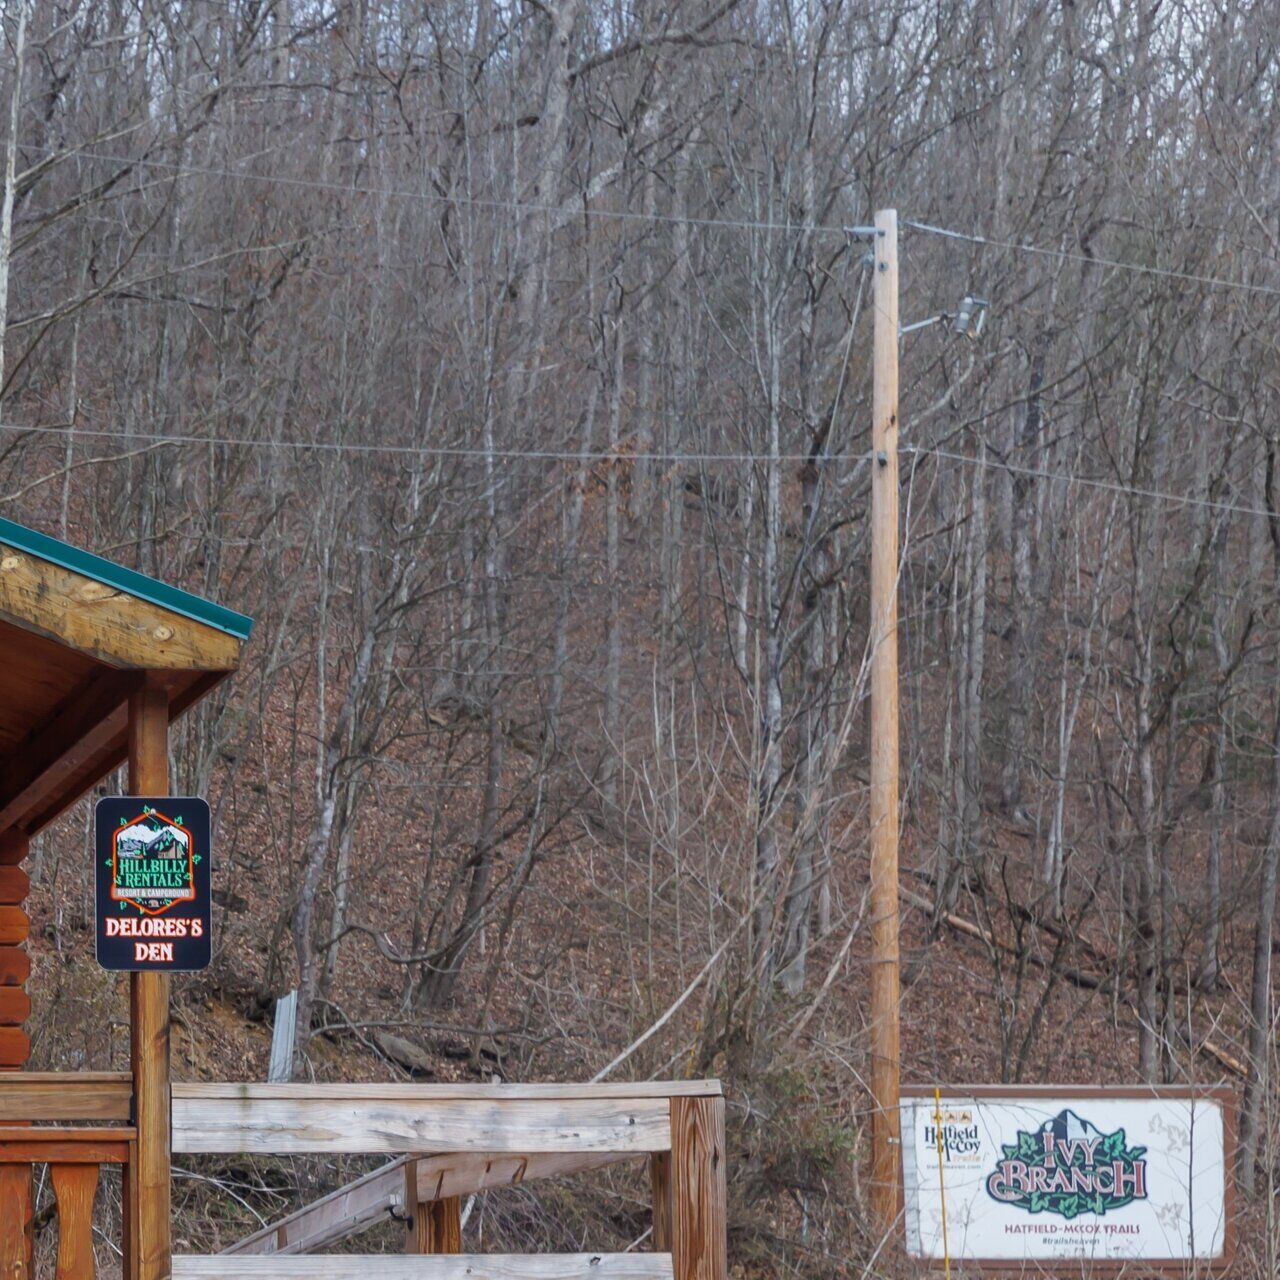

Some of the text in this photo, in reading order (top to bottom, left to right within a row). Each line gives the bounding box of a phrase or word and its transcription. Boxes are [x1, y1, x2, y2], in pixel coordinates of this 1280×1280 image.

[120, 859, 187, 875] HILLBILLY
[125, 873, 183, 888] RENTALS
[117, 889, 140, 897] RESORT
[147, 889, 190, 897] CAMPGROUND
[106, 917, 203, 937] DELORES'S
[135, 942, 174, 962] DEN
[1043, 1131, 1103, 1168] IVY
[989, 1159, 1146, 1200] BRANCH
[1103, 1223, 1141, 1235] TRAILS
